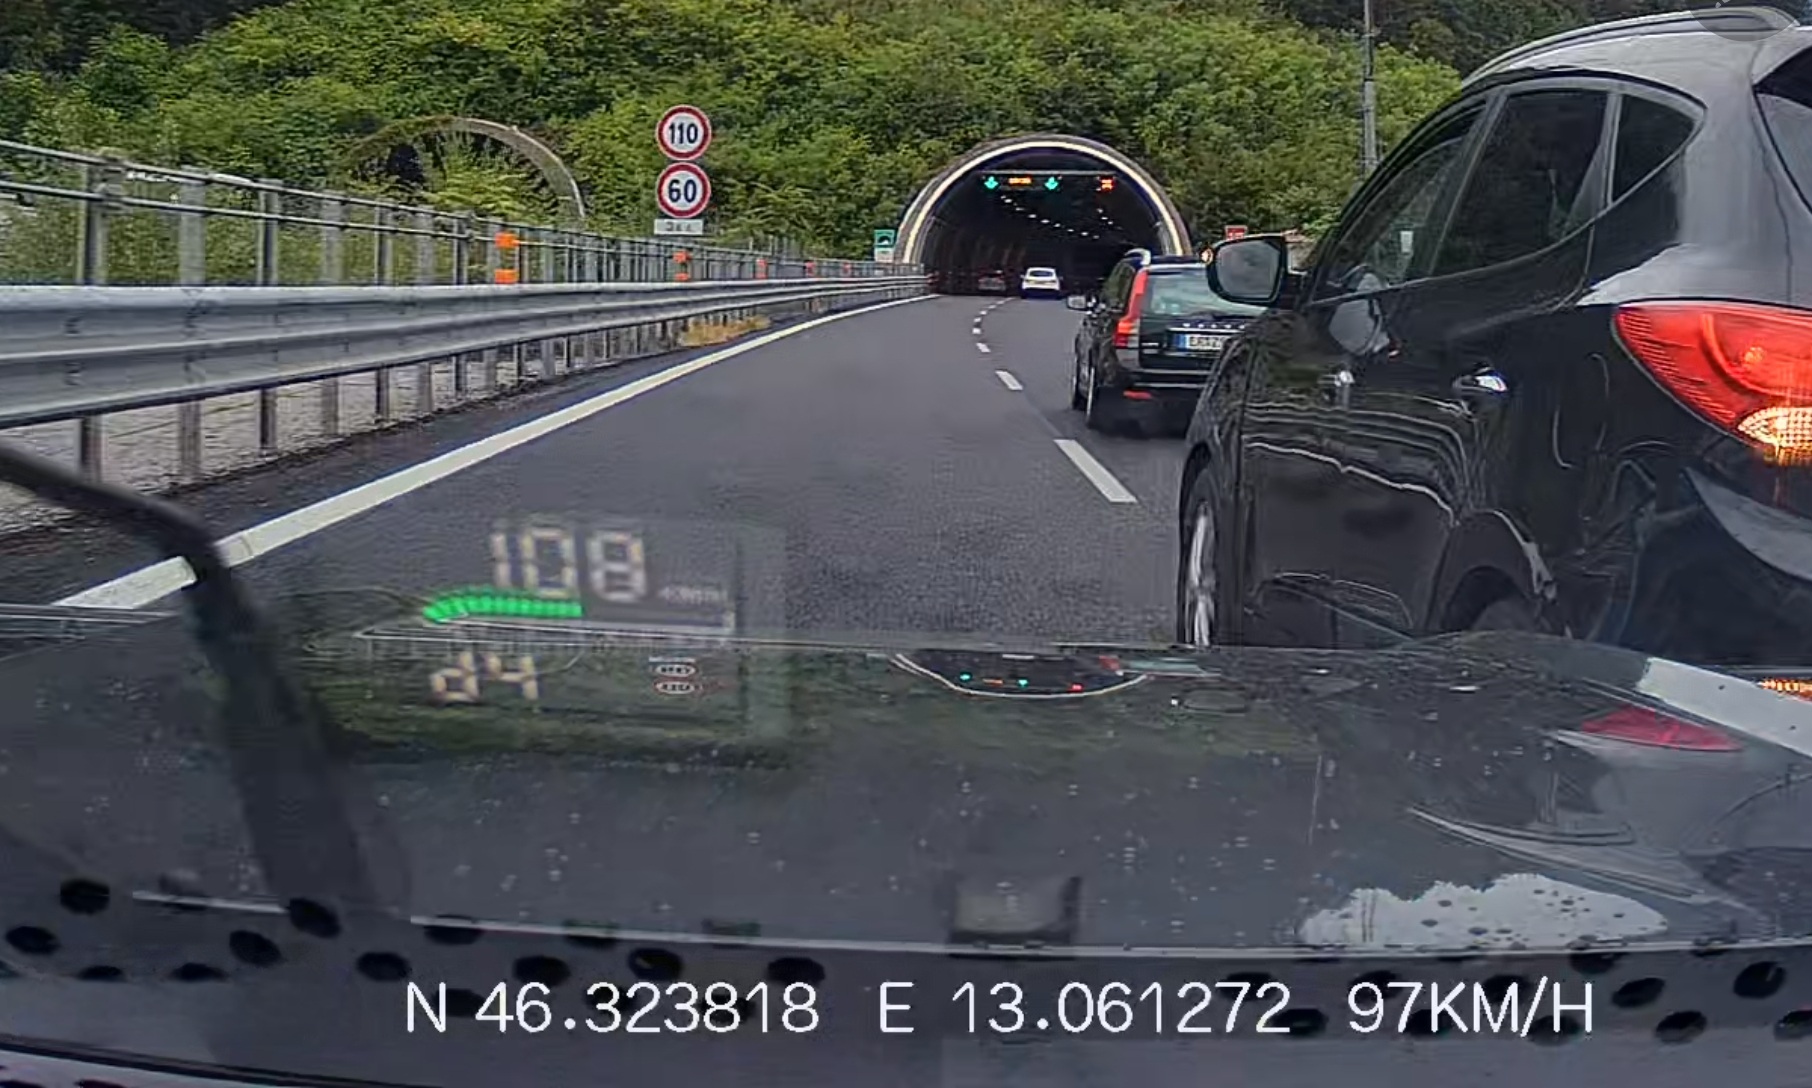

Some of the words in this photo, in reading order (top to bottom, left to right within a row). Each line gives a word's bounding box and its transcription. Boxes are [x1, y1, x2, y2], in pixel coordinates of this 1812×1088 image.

[668, 122, 698, 144] 110
[668, 179, 698, 203] 60
[490, 526, 648, 603] 108
